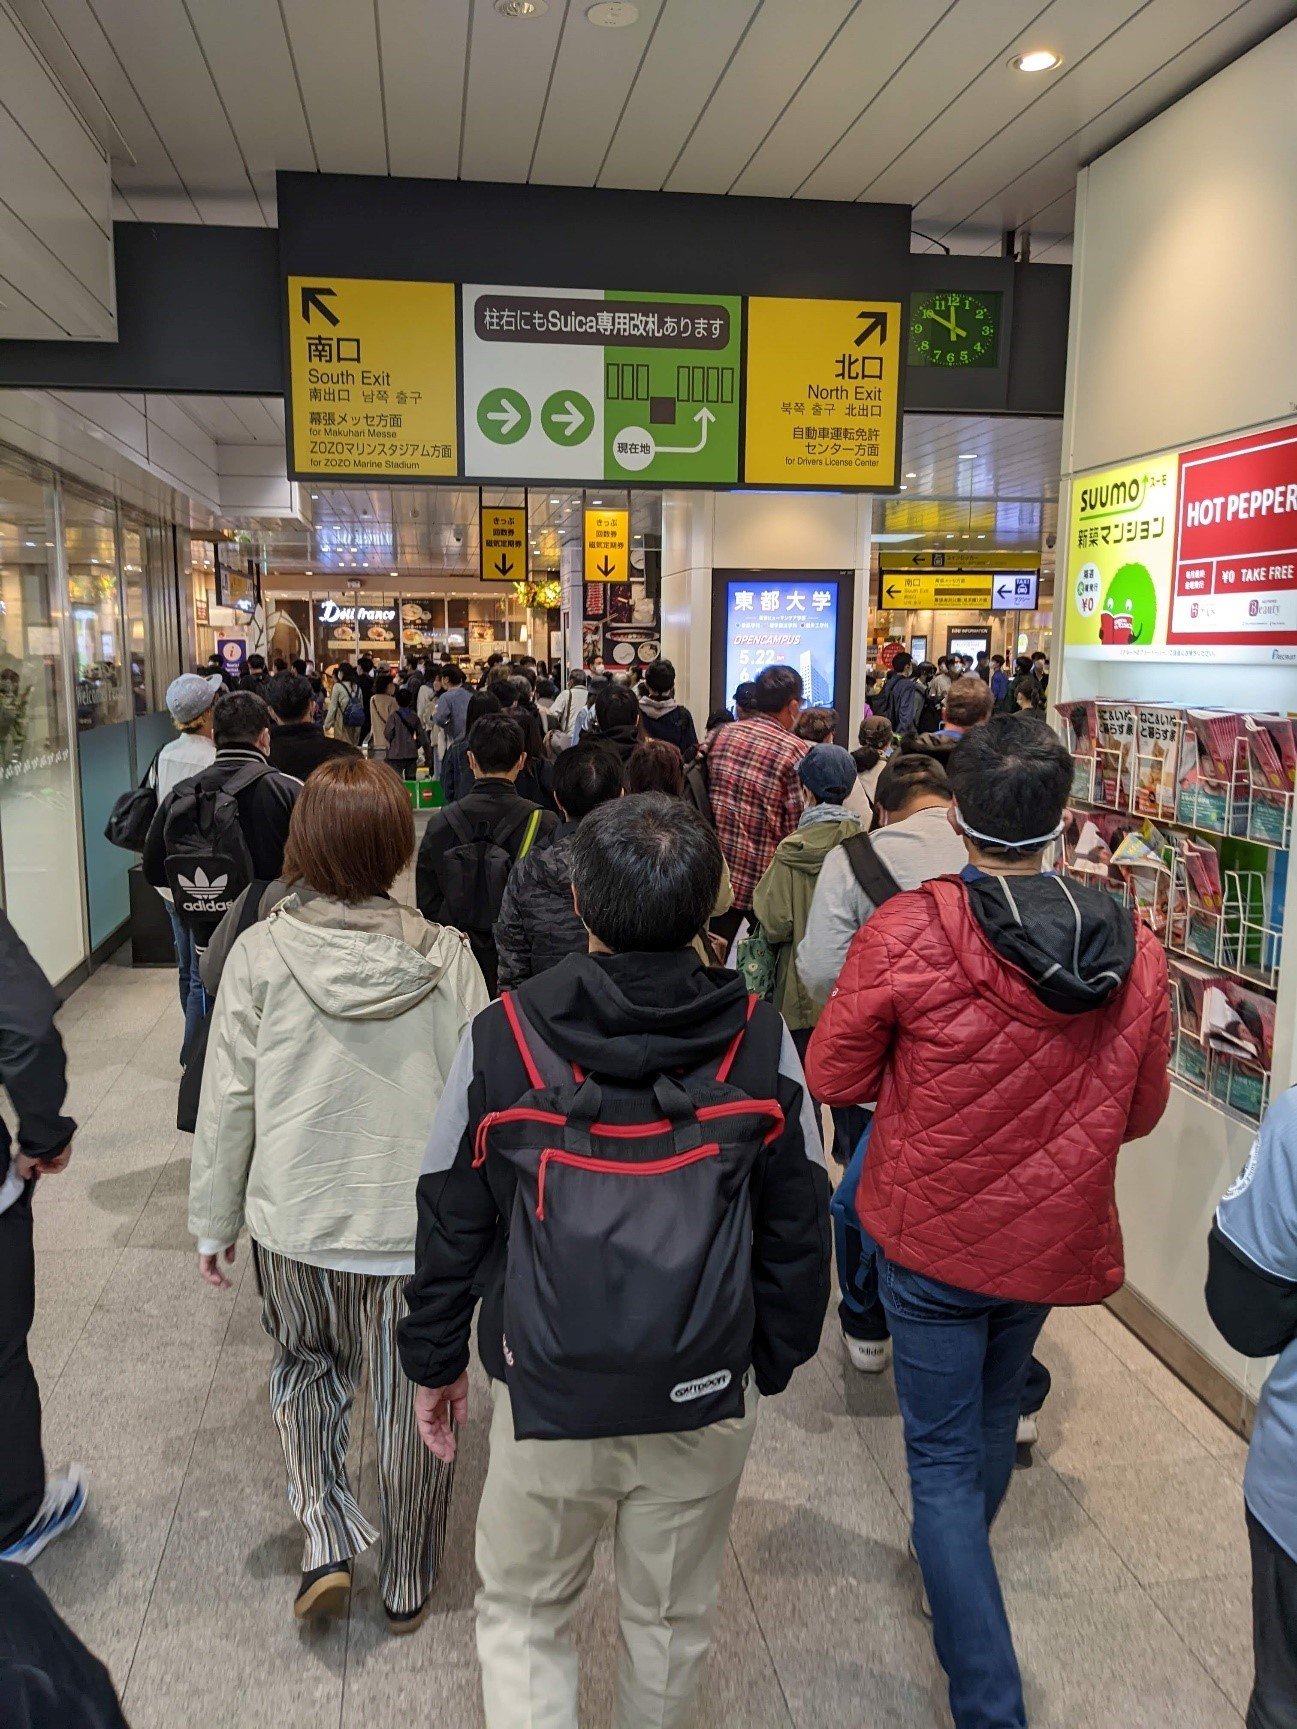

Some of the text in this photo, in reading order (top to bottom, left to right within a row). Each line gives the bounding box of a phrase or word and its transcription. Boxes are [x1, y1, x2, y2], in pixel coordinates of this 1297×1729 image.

[935, 301, 945, 310] 11
[948, 296, 959, 306] 12
[966, 300, 971, 310] 1
[975, 310, 983, 319] 2
[484, 307, 724, 338] 柱右にもSuica専用改札あります
[914, 324, 922, 334] 9
[982, 325, 990, 336] 3
[306, 335, 361, 363] 南口
[921, 341, 929, 352] 8
[974, 343, 981, 353] 4
[934, 351, 941, 362] 7
[947, 354, 954, 363] 6
[961, 351, 970, 361] 5
[835, 354, 884, 381] 北口
[308, 368, 391, 387] South Exit
[309, 388, 422, 405] 南出口 남쪽 출구
[808, 385, 882, 402] North Exit
[811, 403, 836, 417] 출구
[845, 404, 882, 418] 北出口
[309, 411, 403, 428] 幕張メッセ方面
[309, 428, 397, 440] for Makuhari Messe
[793, 426, 881, 442] 自動車運転免許
[310, 441, 453, 459] ZOZOマリンスタジアム方面
[617, 443, 651, 456] 現在地
[805, 443, 880, 457] センター方面
[310, 457, 420, 470] for ZOZO Marine Stadium
[785, 456, 880, 468] for Drivers License Center
[1150, 474, 1168, 488] スーモ
[1080, 479, 1140, 513] SUUMO
[1187, 483, 1297, 528] HOT PEPPER
[494, 517, 514, 526] きっぷ
[597, 518, 618, 527] きっぷ
[493, 530, 515, 538] 回数券
[596, 531, 617, 539] 回数券
[1078, 515, 1165, 550] 新築マンション
[1221, 564, 1295, 584] ¥0 TAKE FREE
[905, 578, 920, 588] 南口
[734, 590, 832, 612] 東都大学
[1082, 597, 1094, 612] ¥0
[739, 649, 775, 666] 5.22
